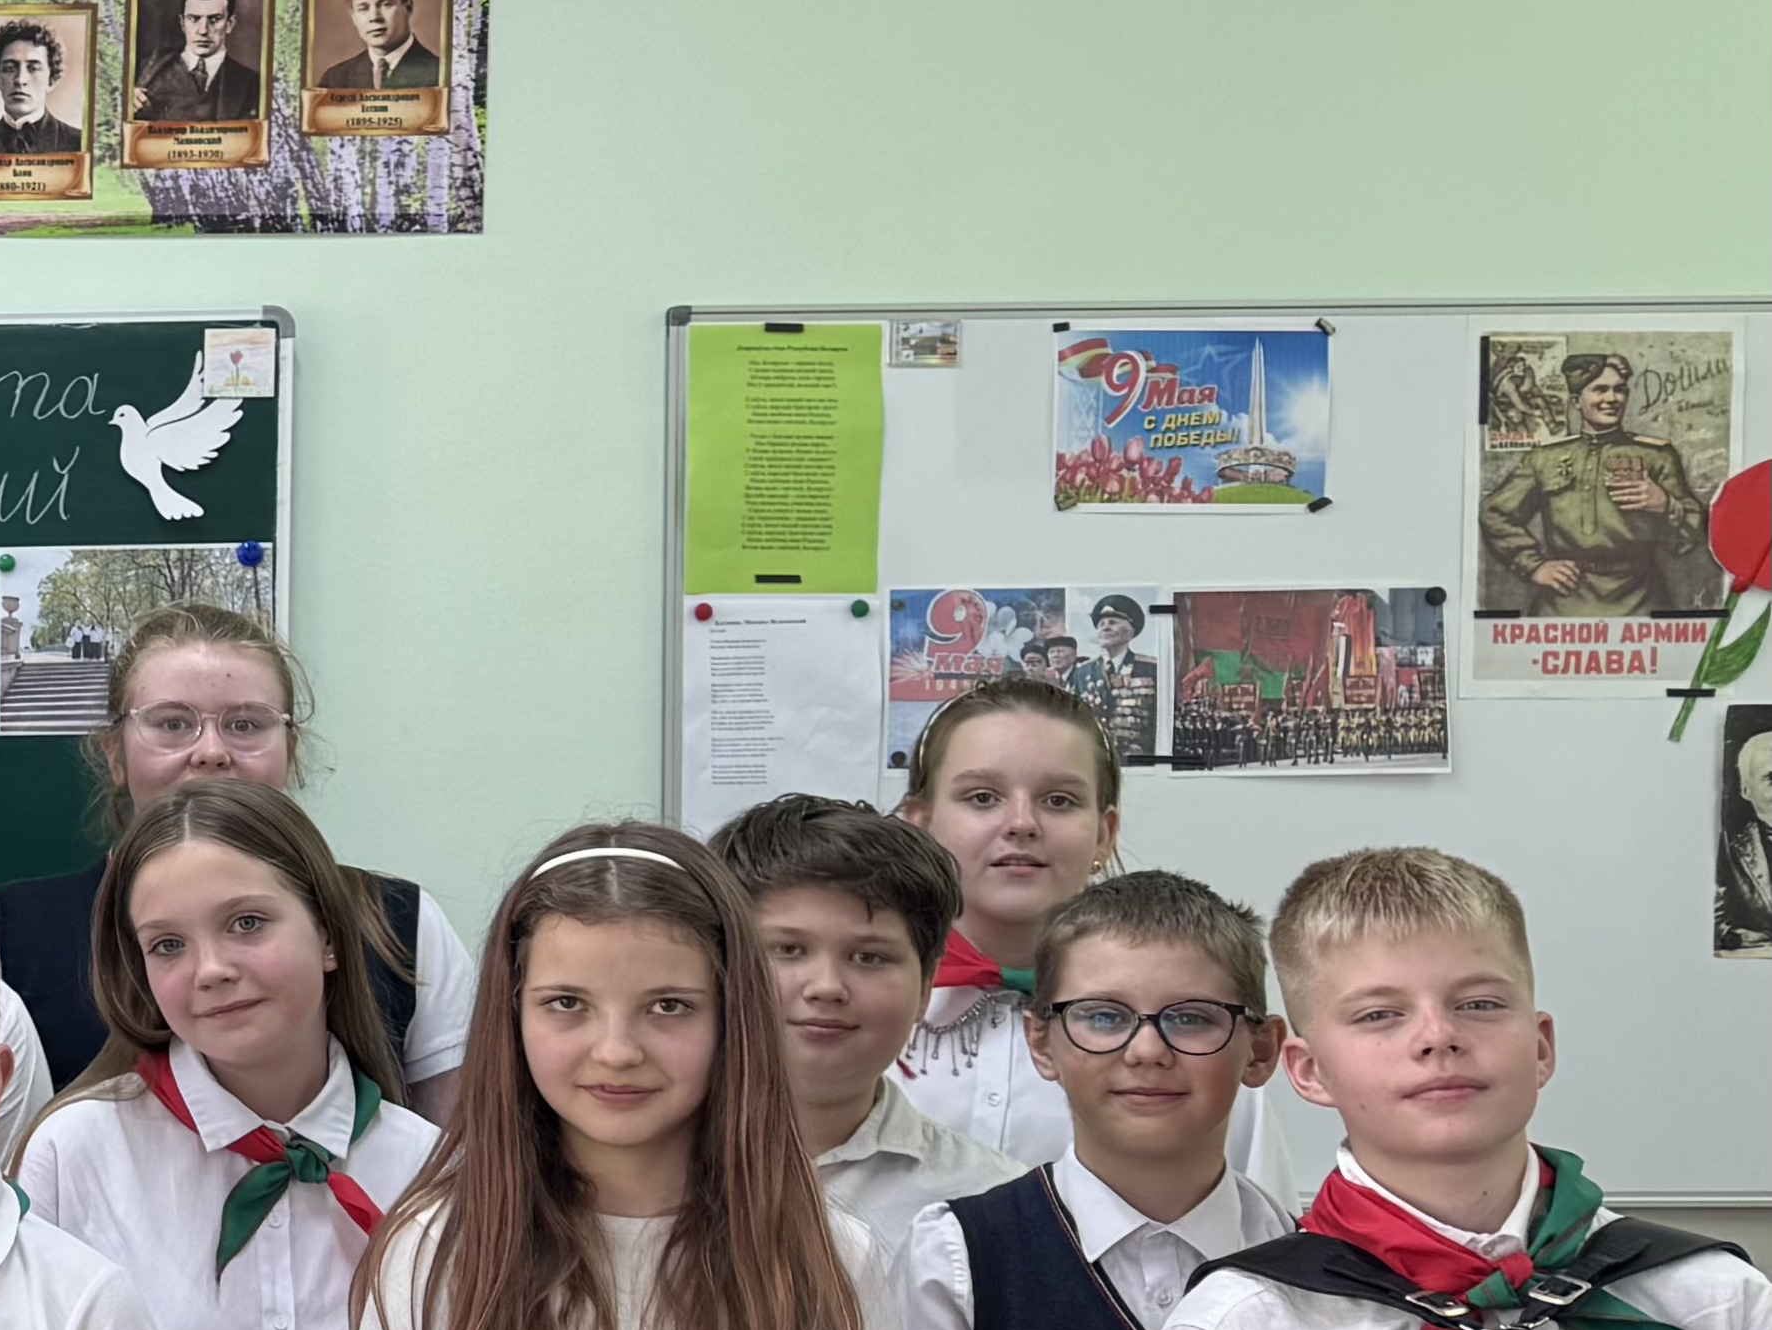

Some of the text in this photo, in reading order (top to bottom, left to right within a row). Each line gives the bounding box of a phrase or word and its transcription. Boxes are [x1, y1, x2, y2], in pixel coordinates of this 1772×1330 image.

[345, 116, 403, 128] (1895-1925)
[1103, 349, 1218, 428] 9 Мая
[1161, 410, 1223, 432] ДНЕМ
[1149, 427, 1241, 450] ПОБЕДЫ!
[925, 588, 989, 659] 9
[1492, 619, 1709, 645] КРАСНОЙ АРМИИ
